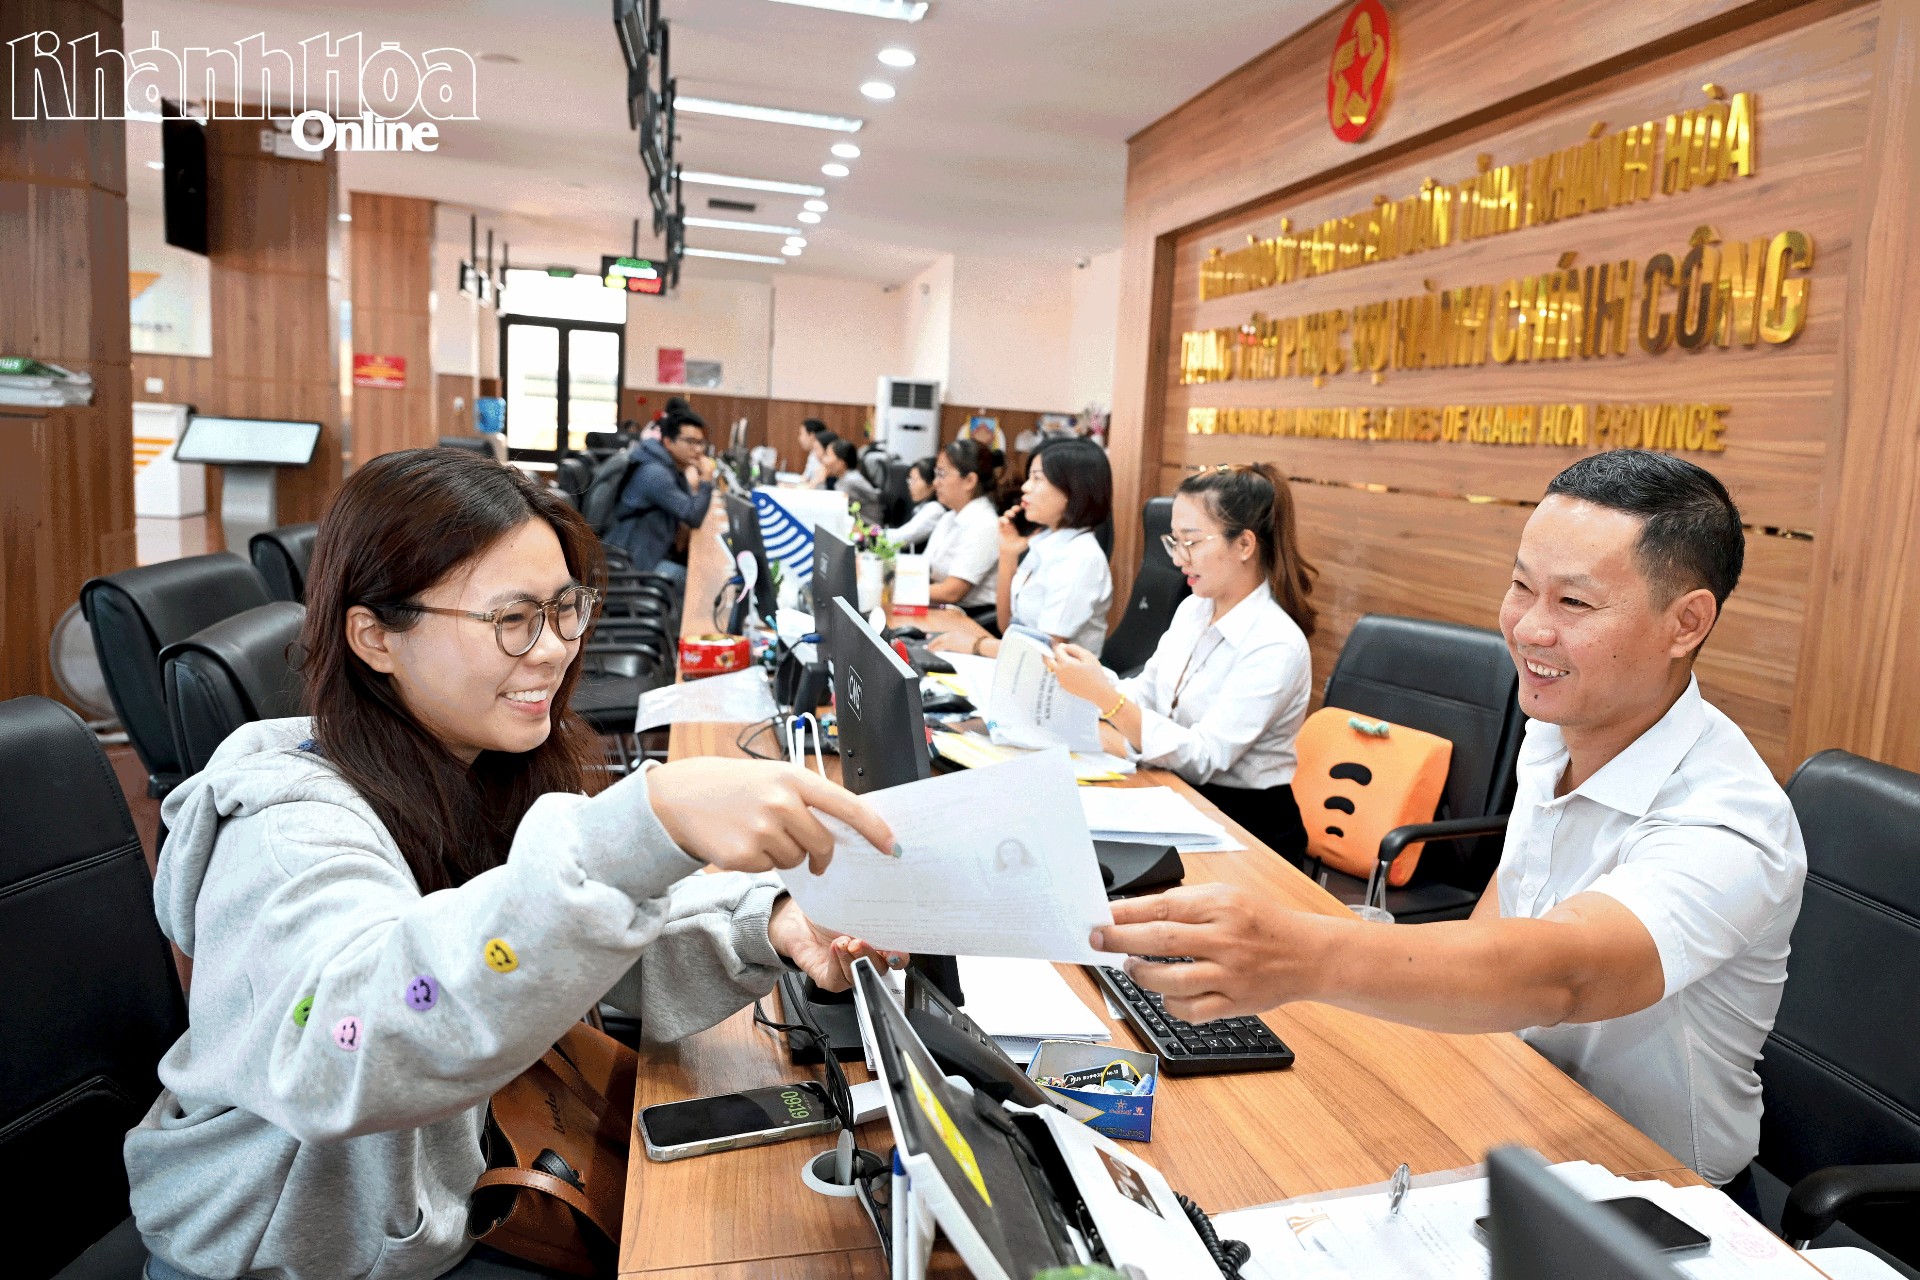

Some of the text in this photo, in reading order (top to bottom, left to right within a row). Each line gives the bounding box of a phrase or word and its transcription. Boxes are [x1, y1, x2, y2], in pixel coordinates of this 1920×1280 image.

[1526, 120, 1656, 224] KHÁNH
[1660, 82, 1758, 194] HÒA
[1280, 308, 1347, 389] PHỤC
[1351, 299, 1392, 386] VỤ
[1392, 278, 1492, 371] HÀNH
[1491, 250, 1637, 364] CHÍNH
[1638, 224, 1814, 355] CÔNG
[1442, 406, 1467, 442] OF
[1466, 405, 1538, 444] KHANH
[1540, 404, 1588, 446] HOA
[1595, 404, 1731, 451] PROVINCE
[780, 1091, 810, 1119] 09:19
